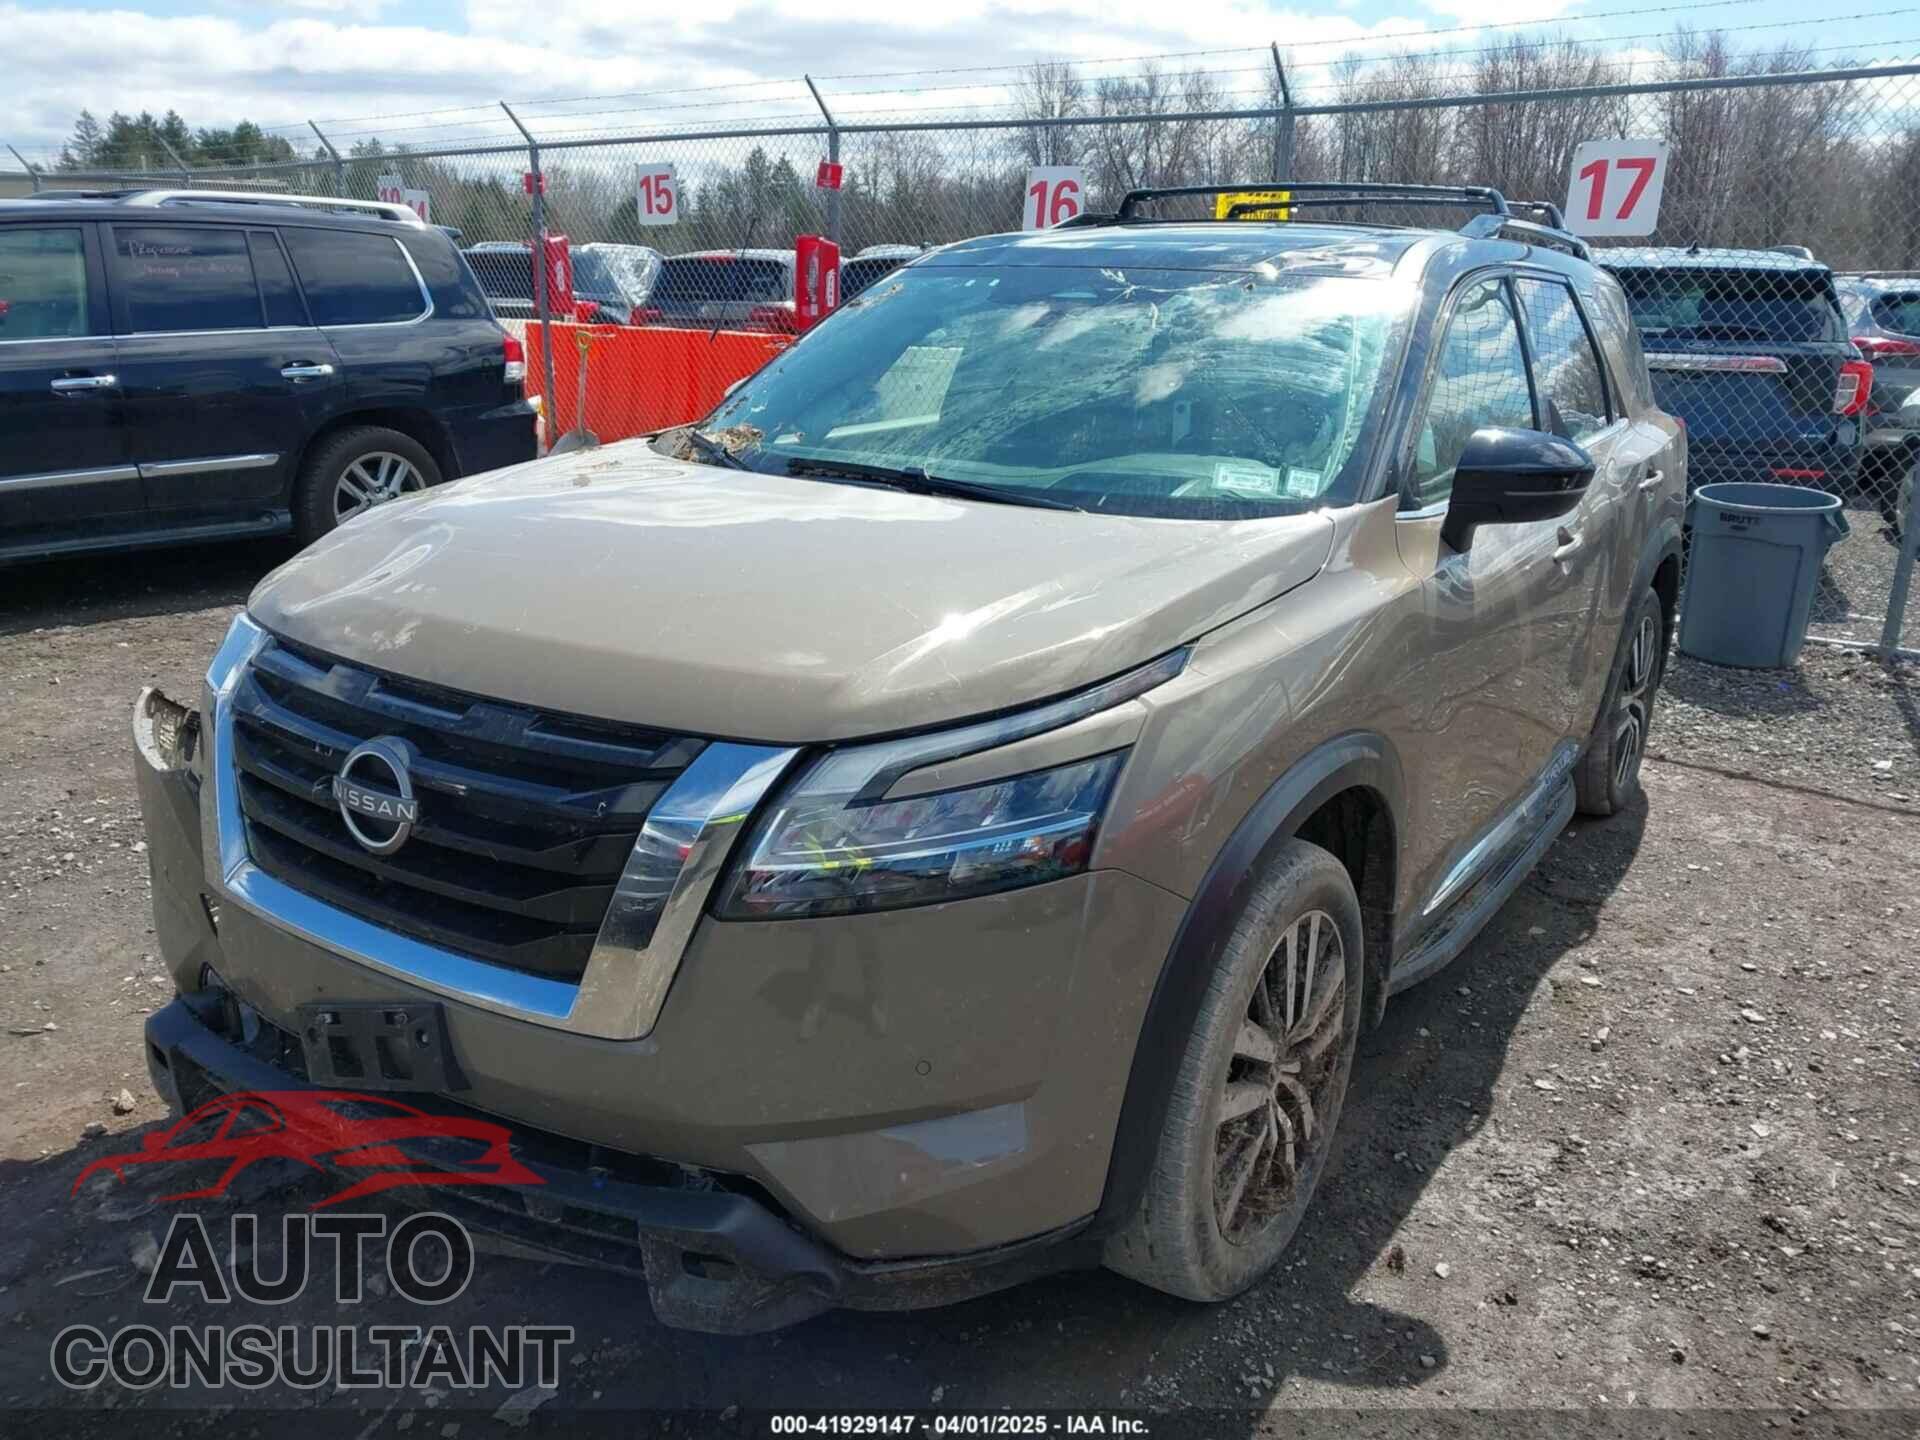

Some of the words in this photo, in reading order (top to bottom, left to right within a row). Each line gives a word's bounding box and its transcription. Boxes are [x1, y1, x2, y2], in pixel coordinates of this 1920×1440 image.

[640, 174, 673, 215] 15
[1029, 179, 1079, 229] 16
[1580, 157, 1657, 220] 17
[333, 778, 415, 820] NISSAN
